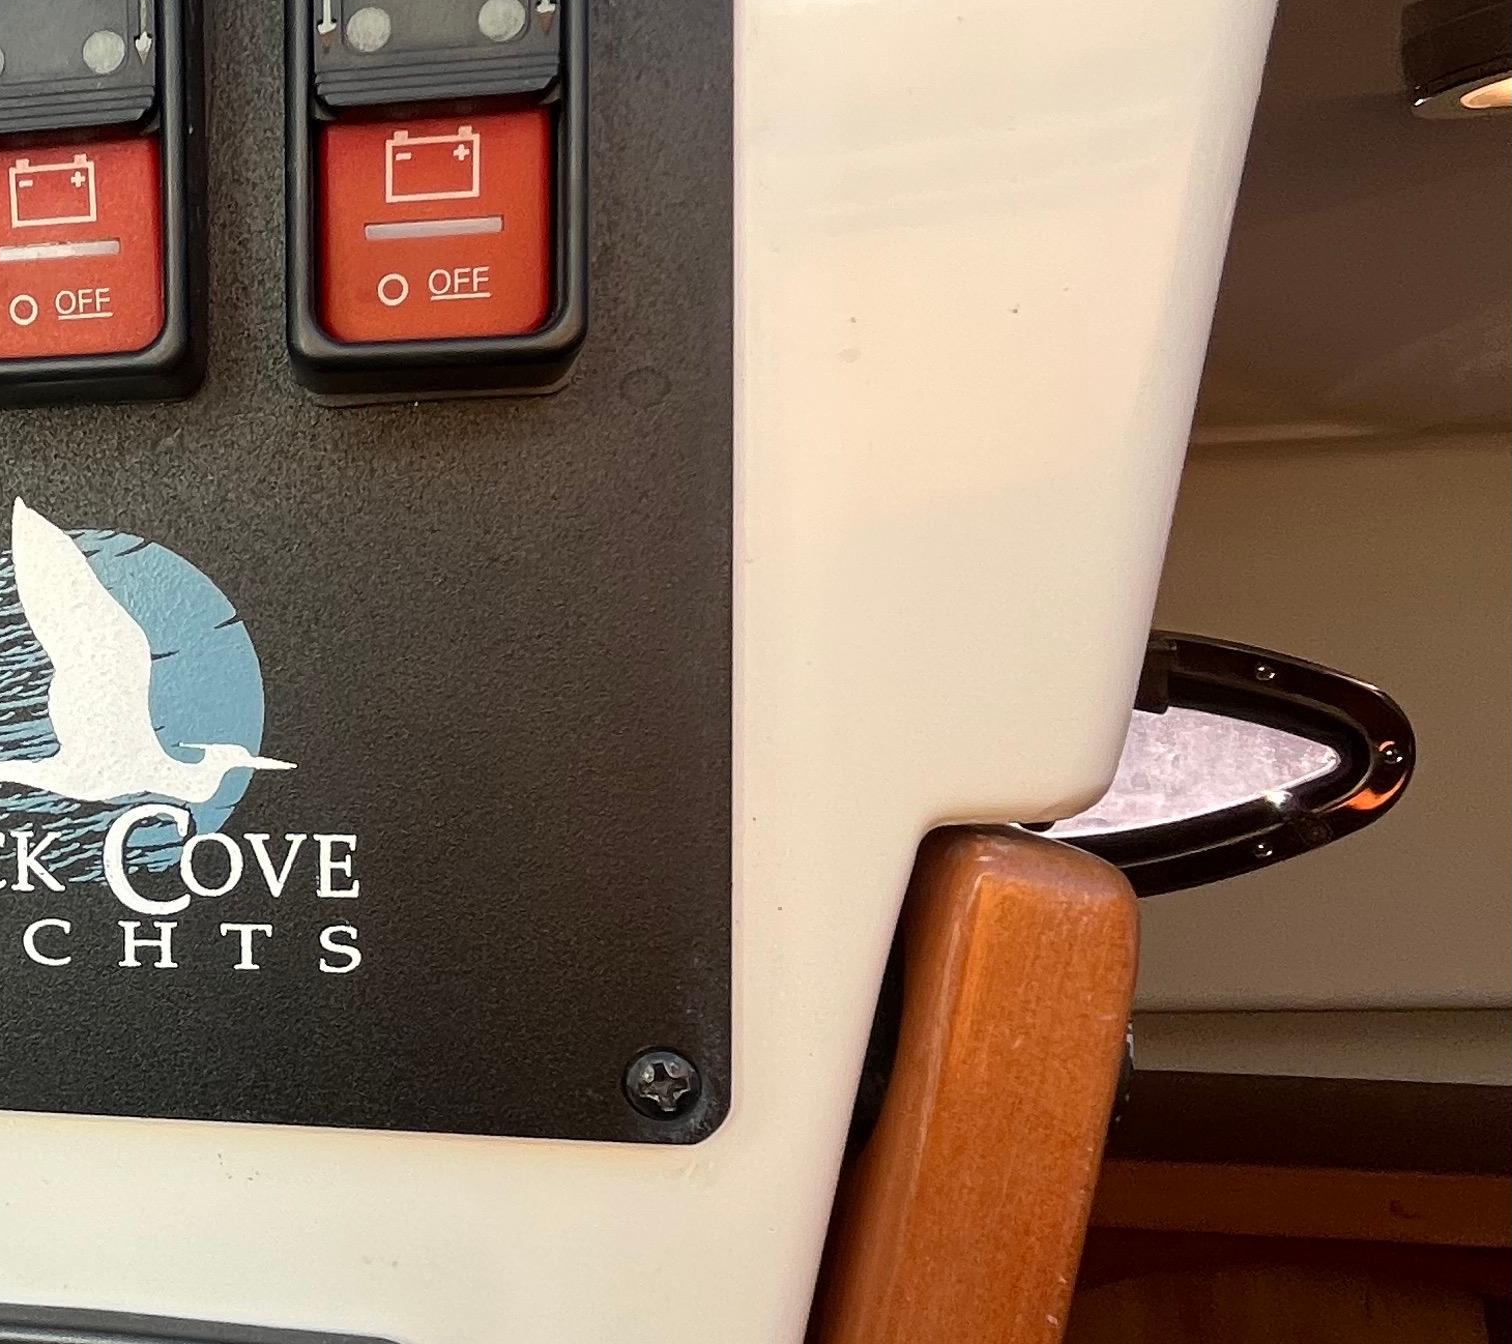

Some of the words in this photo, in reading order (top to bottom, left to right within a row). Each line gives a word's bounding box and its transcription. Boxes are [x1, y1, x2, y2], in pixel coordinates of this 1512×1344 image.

[428, 266, 492, 299] OFF
[54, 287, 114, 319] OFF
[102, 803, 361, 915] COVE
